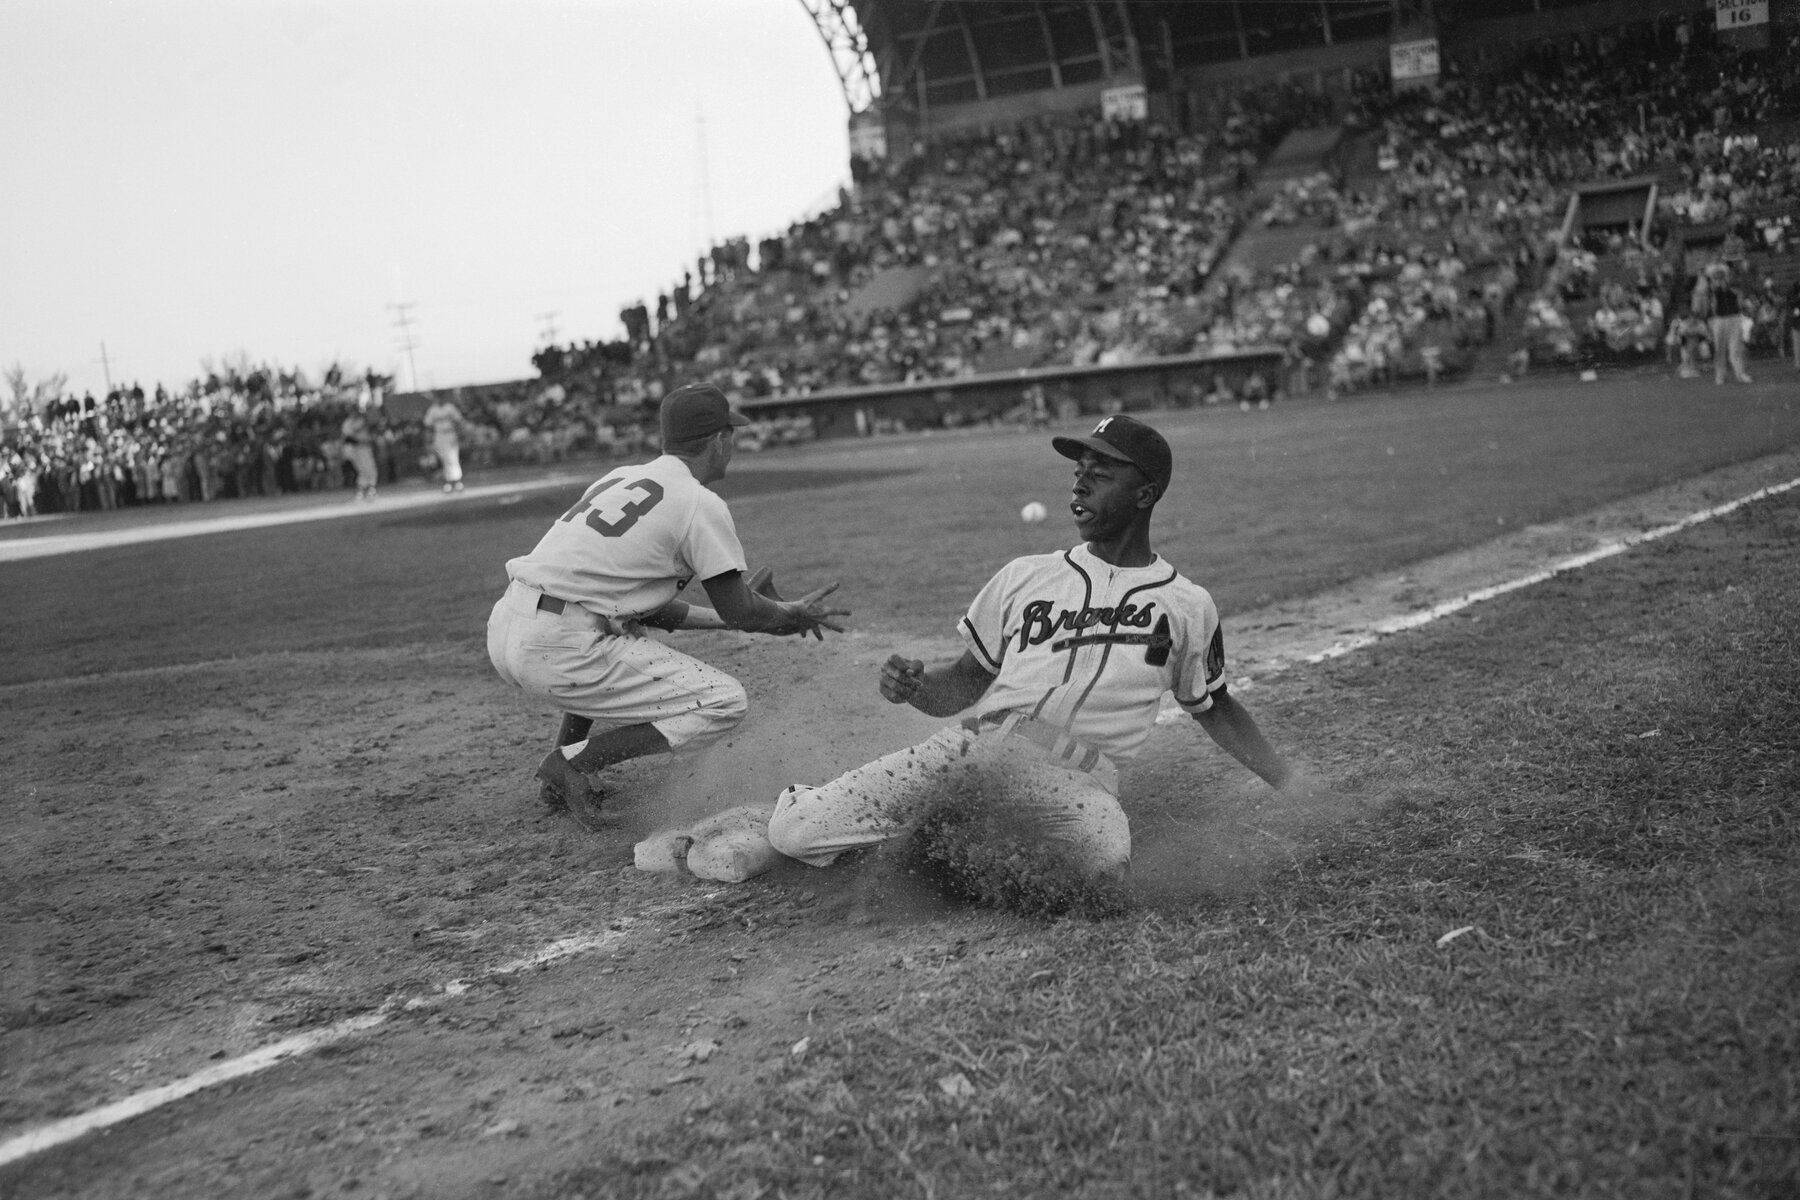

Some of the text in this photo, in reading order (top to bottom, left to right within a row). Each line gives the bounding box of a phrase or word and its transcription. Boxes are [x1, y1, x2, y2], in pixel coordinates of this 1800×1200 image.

[1731, 9, 1751, 23] 16
[1092, 417, 1114, 433] M
[1018, 600, 1156, 653] Braves
